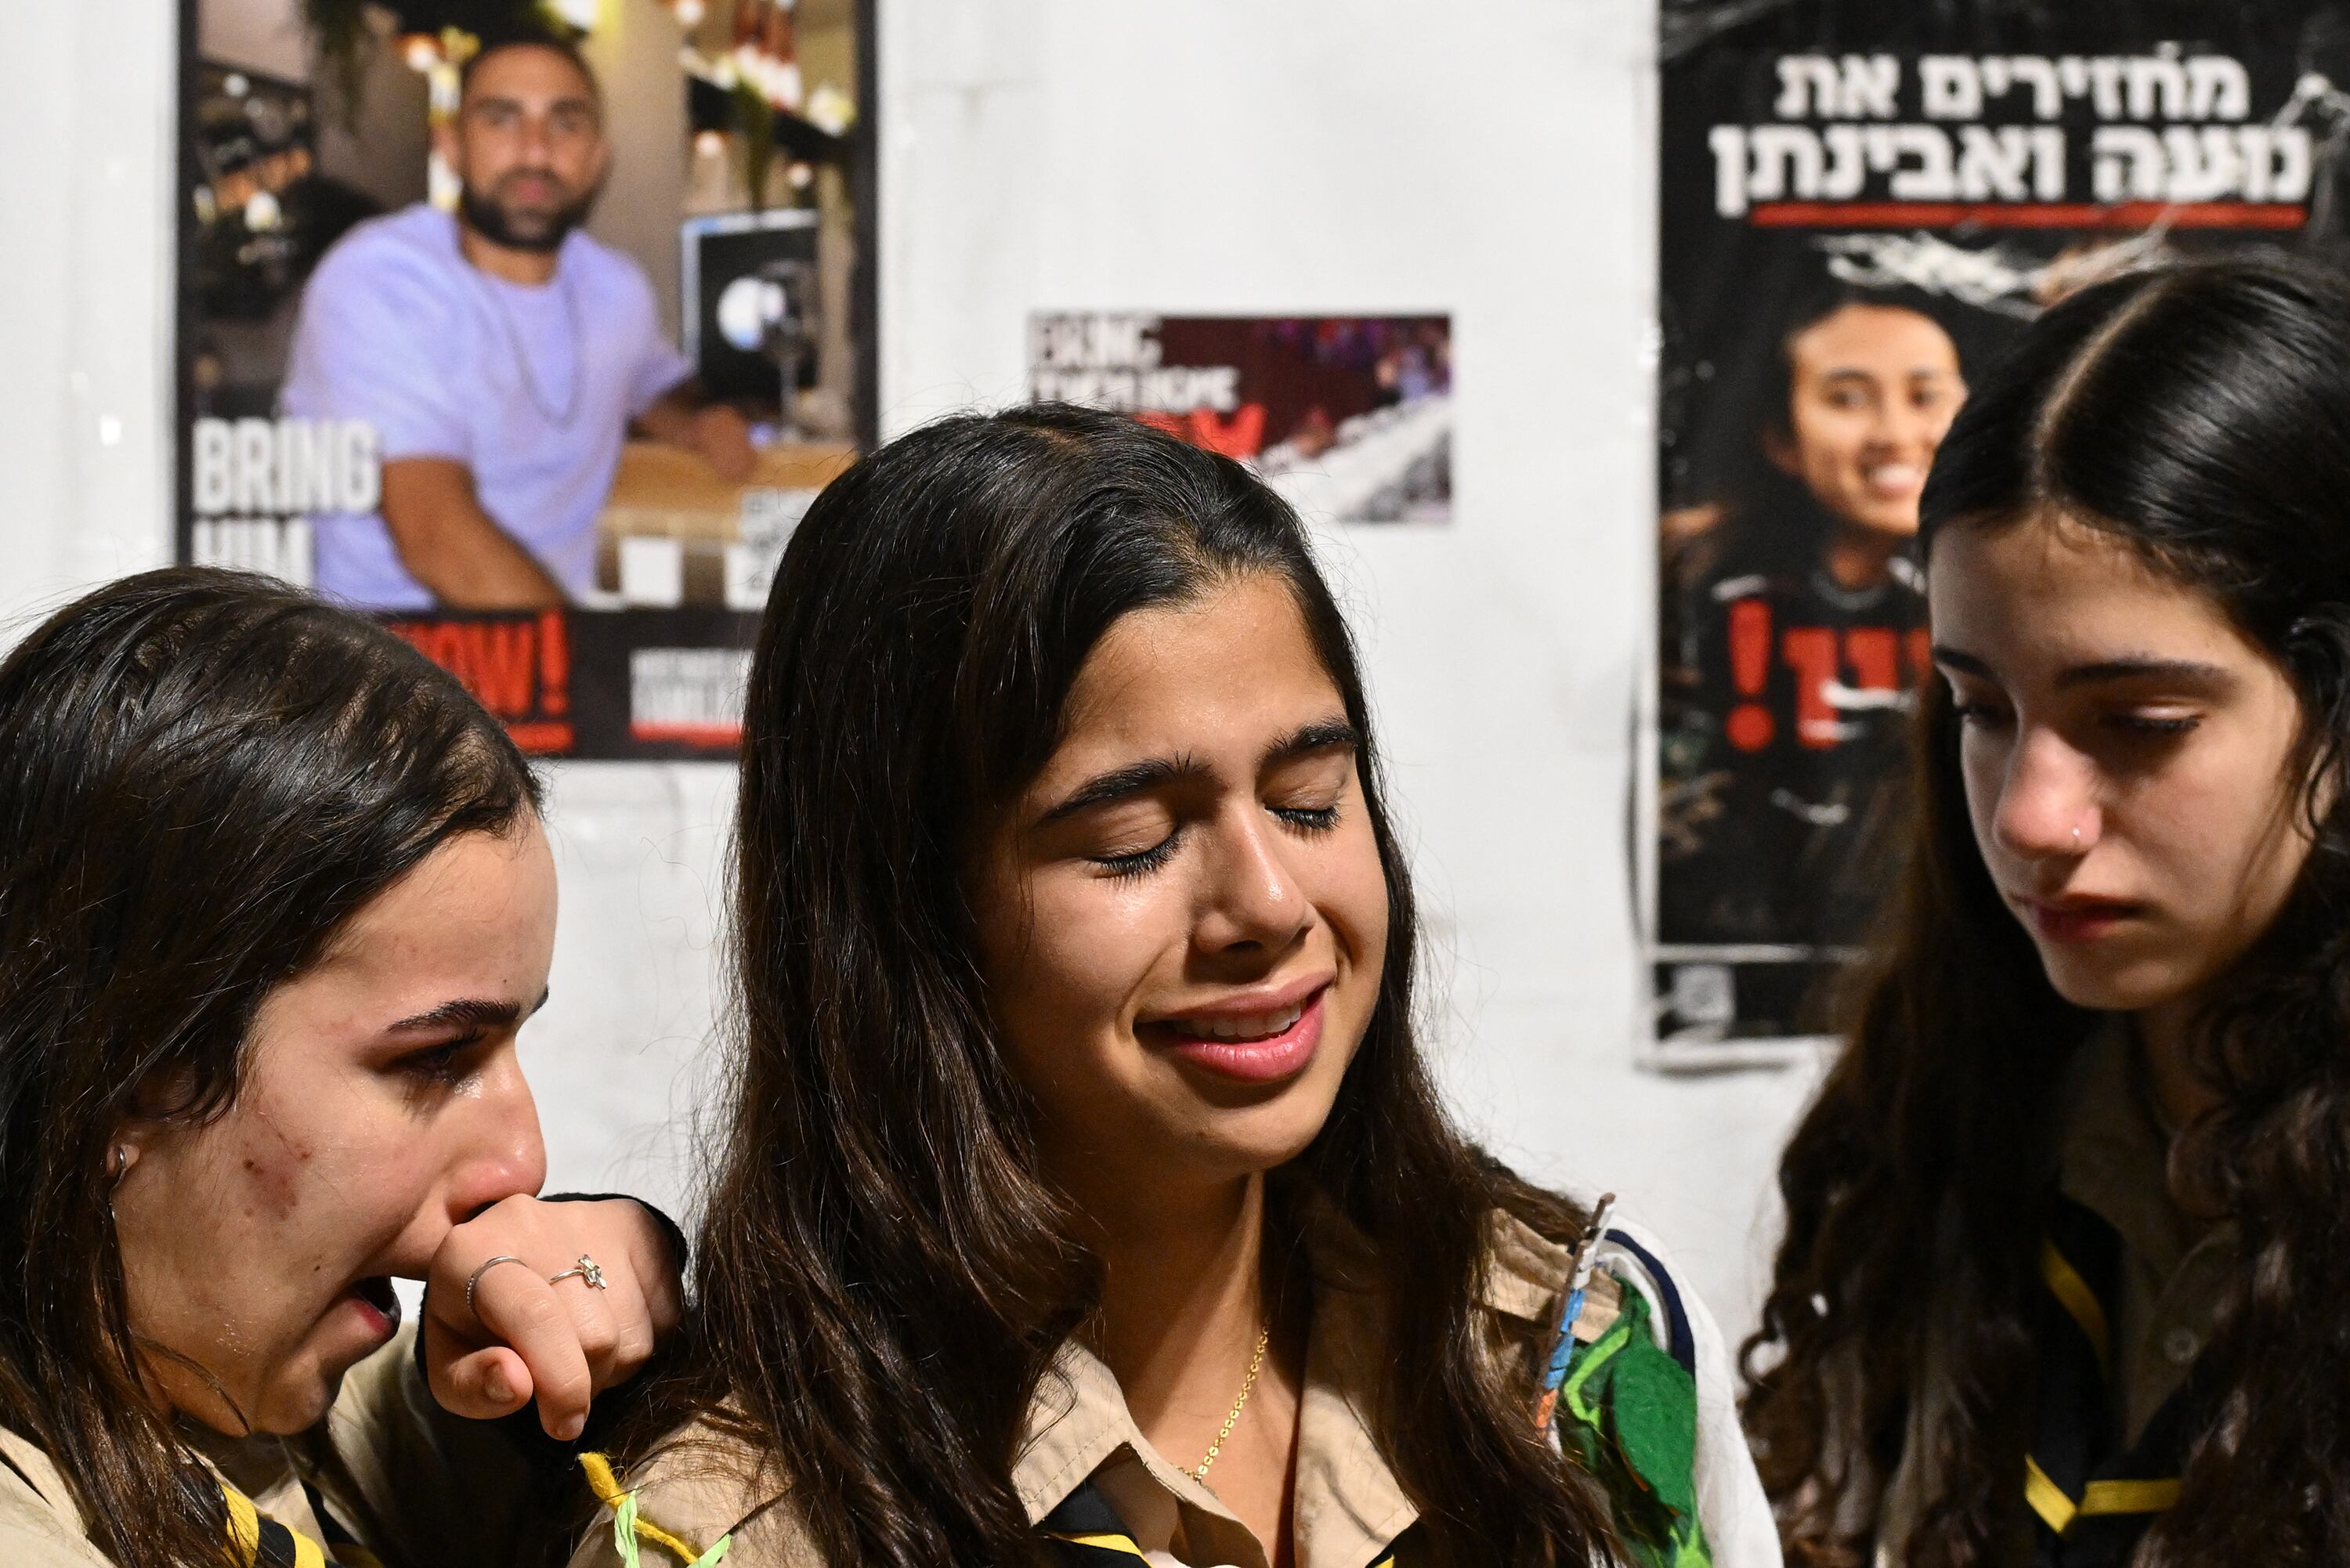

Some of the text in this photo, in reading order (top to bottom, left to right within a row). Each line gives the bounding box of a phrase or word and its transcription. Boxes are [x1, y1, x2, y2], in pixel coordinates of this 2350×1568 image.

[1774, 53, 2251, 120] מחזירים את
[1708, 124, 2066, 219] ואבינתן
[193, 417, 381, 513] BRING
[388, 607, 569, 715] OW!
